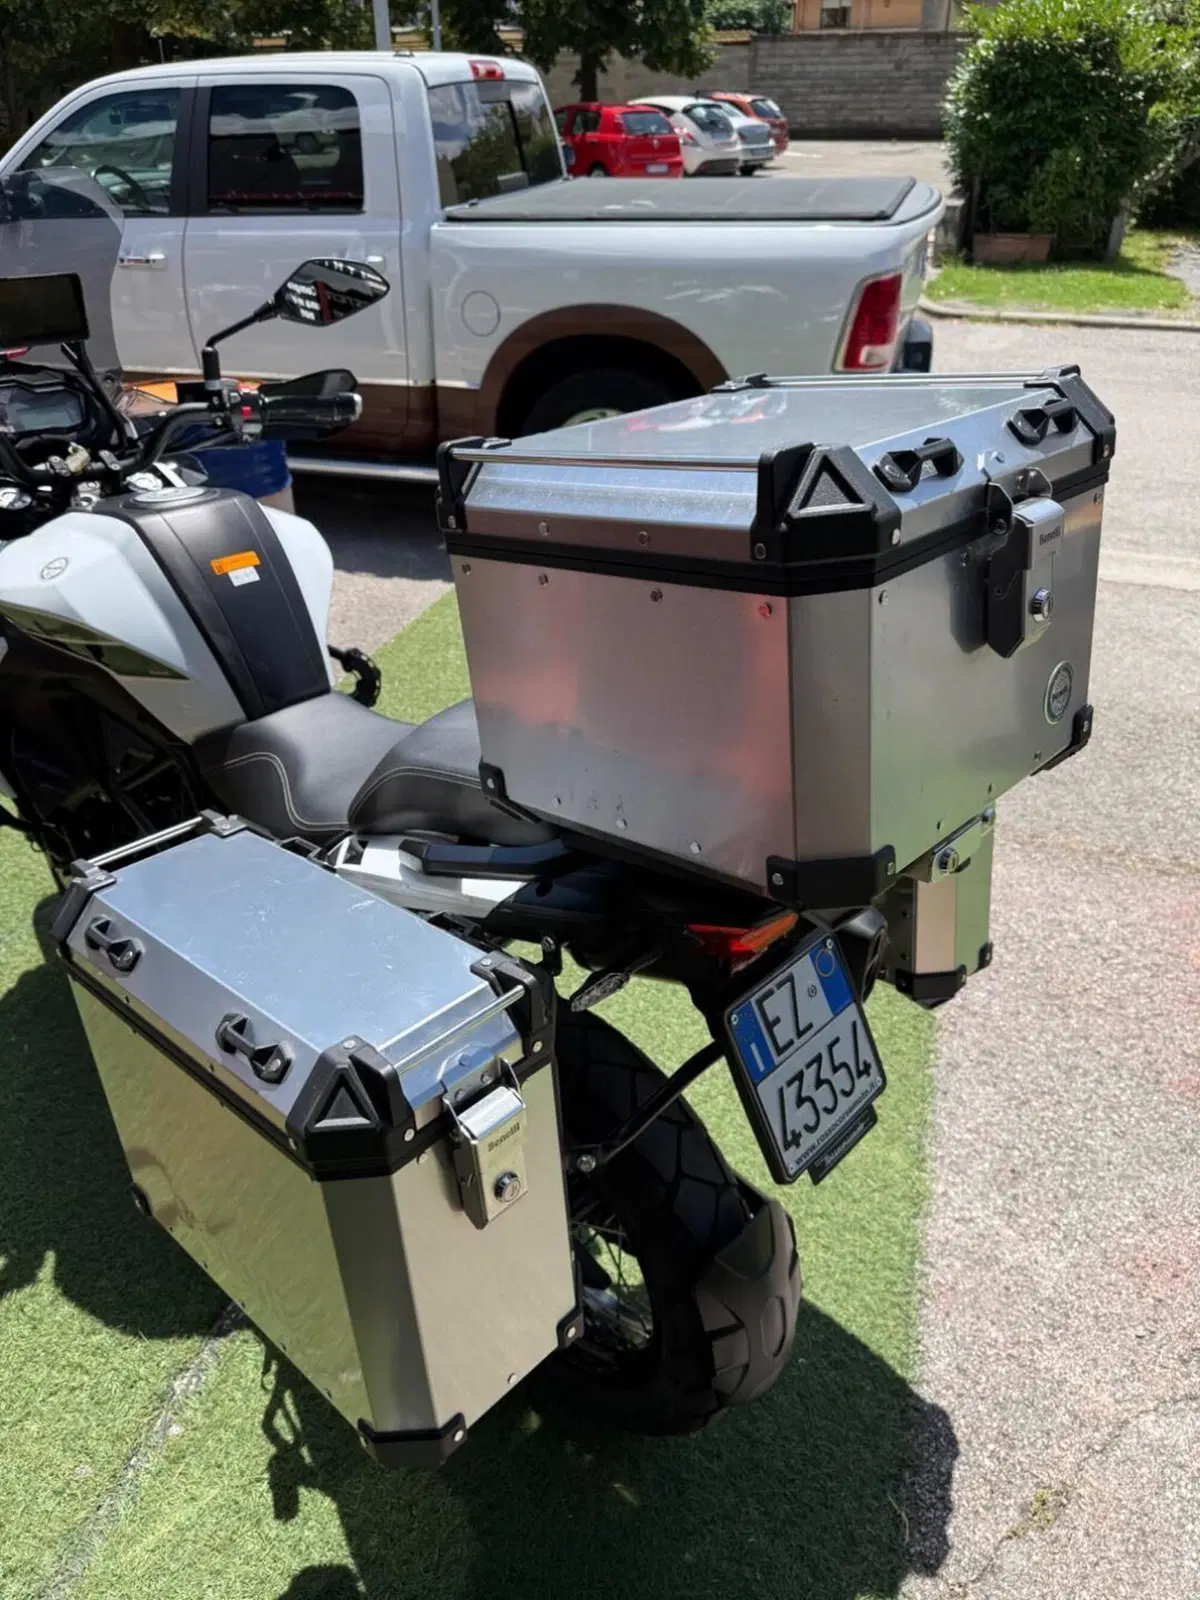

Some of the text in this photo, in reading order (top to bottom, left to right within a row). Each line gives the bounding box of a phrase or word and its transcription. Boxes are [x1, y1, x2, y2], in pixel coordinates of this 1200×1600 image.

[756, 971, 814, 1057] EZ
[777, 1020, 872, 1152] 43354
[488, 1121, 520, 1152] Benelli
